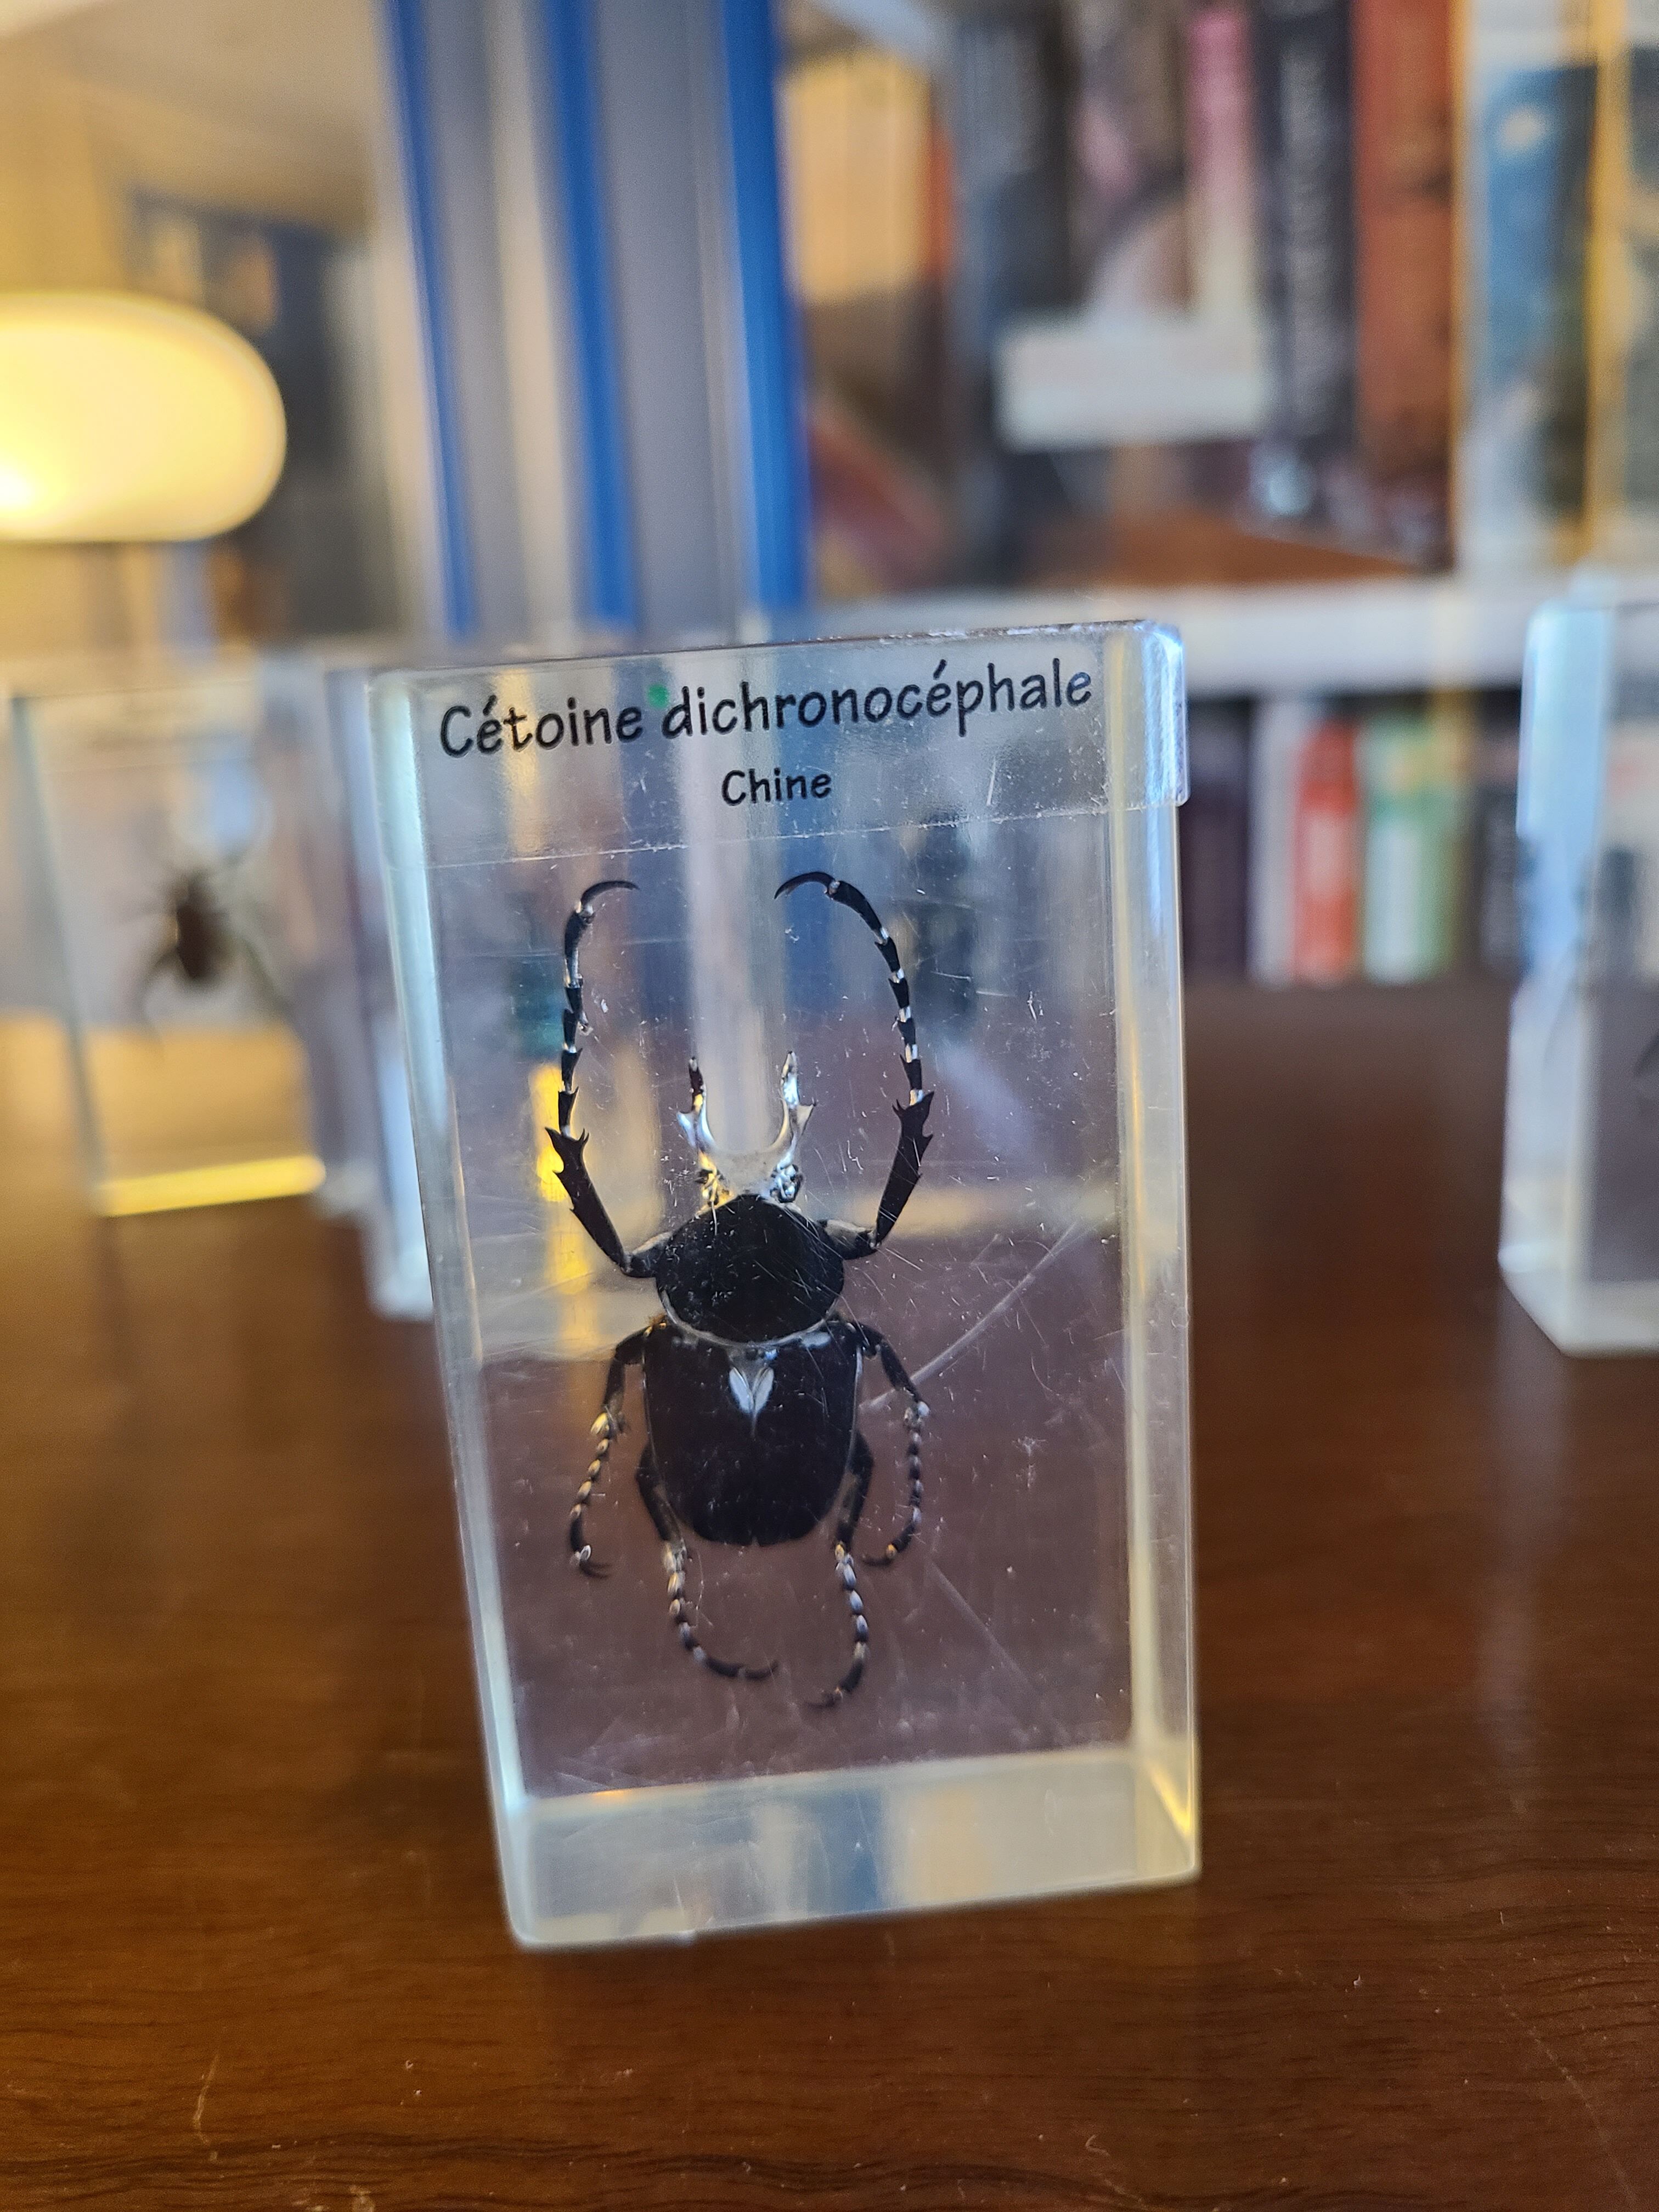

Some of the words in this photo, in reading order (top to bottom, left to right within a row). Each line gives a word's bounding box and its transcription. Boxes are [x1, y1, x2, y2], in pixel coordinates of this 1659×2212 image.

[439, 694, 643, 758] Cétoine
[661, 658, 1092, 739] dichronocéphale
[721, 768, 832, 806] Chine
